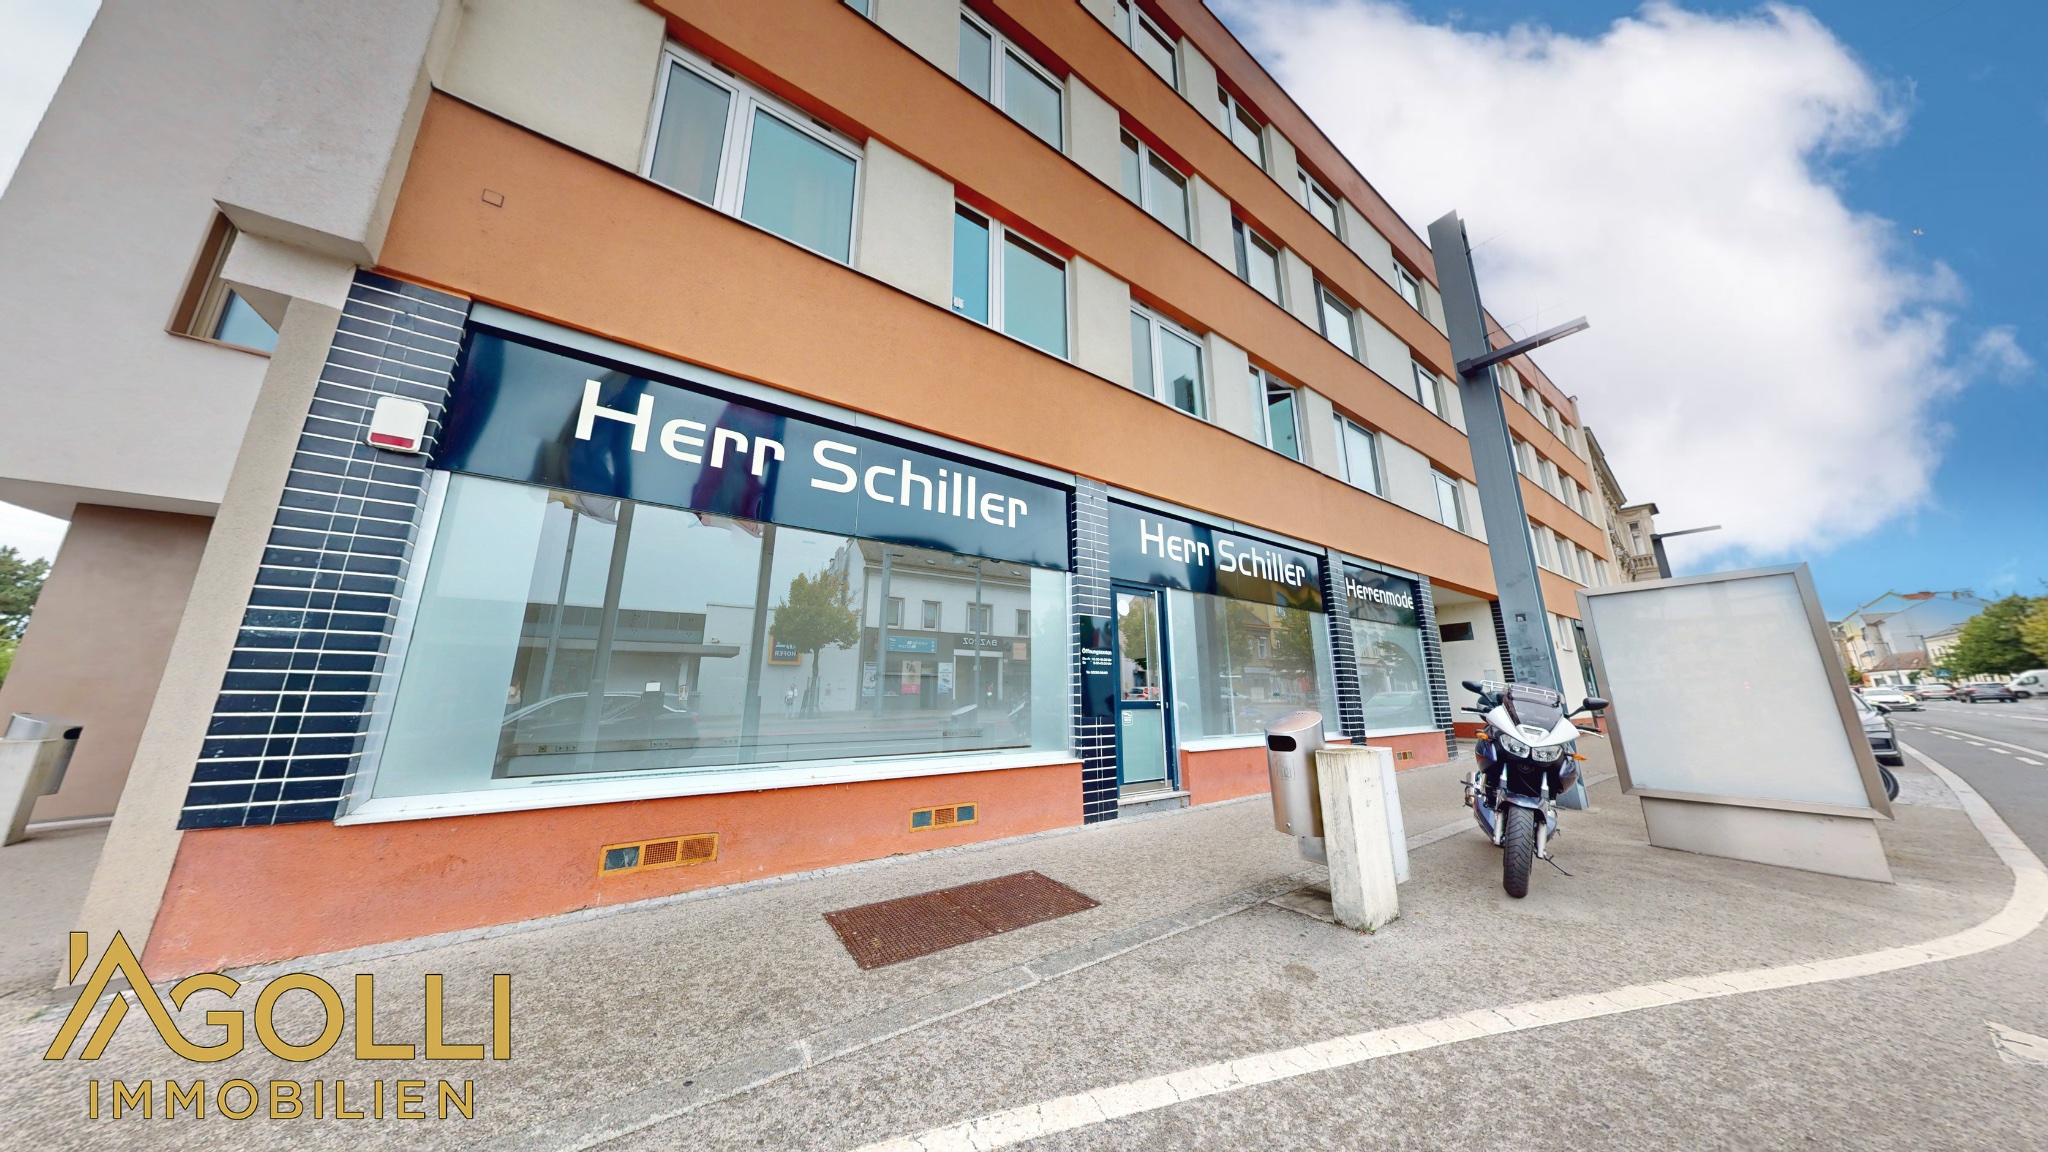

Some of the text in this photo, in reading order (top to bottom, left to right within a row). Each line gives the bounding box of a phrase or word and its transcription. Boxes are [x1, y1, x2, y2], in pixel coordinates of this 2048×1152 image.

[575, 379, 1029, 530] Herr Schiller
[1140, 517, 1306, 587] Herr Schiller
[1345, 577, 1415, 611] Herrenmode
